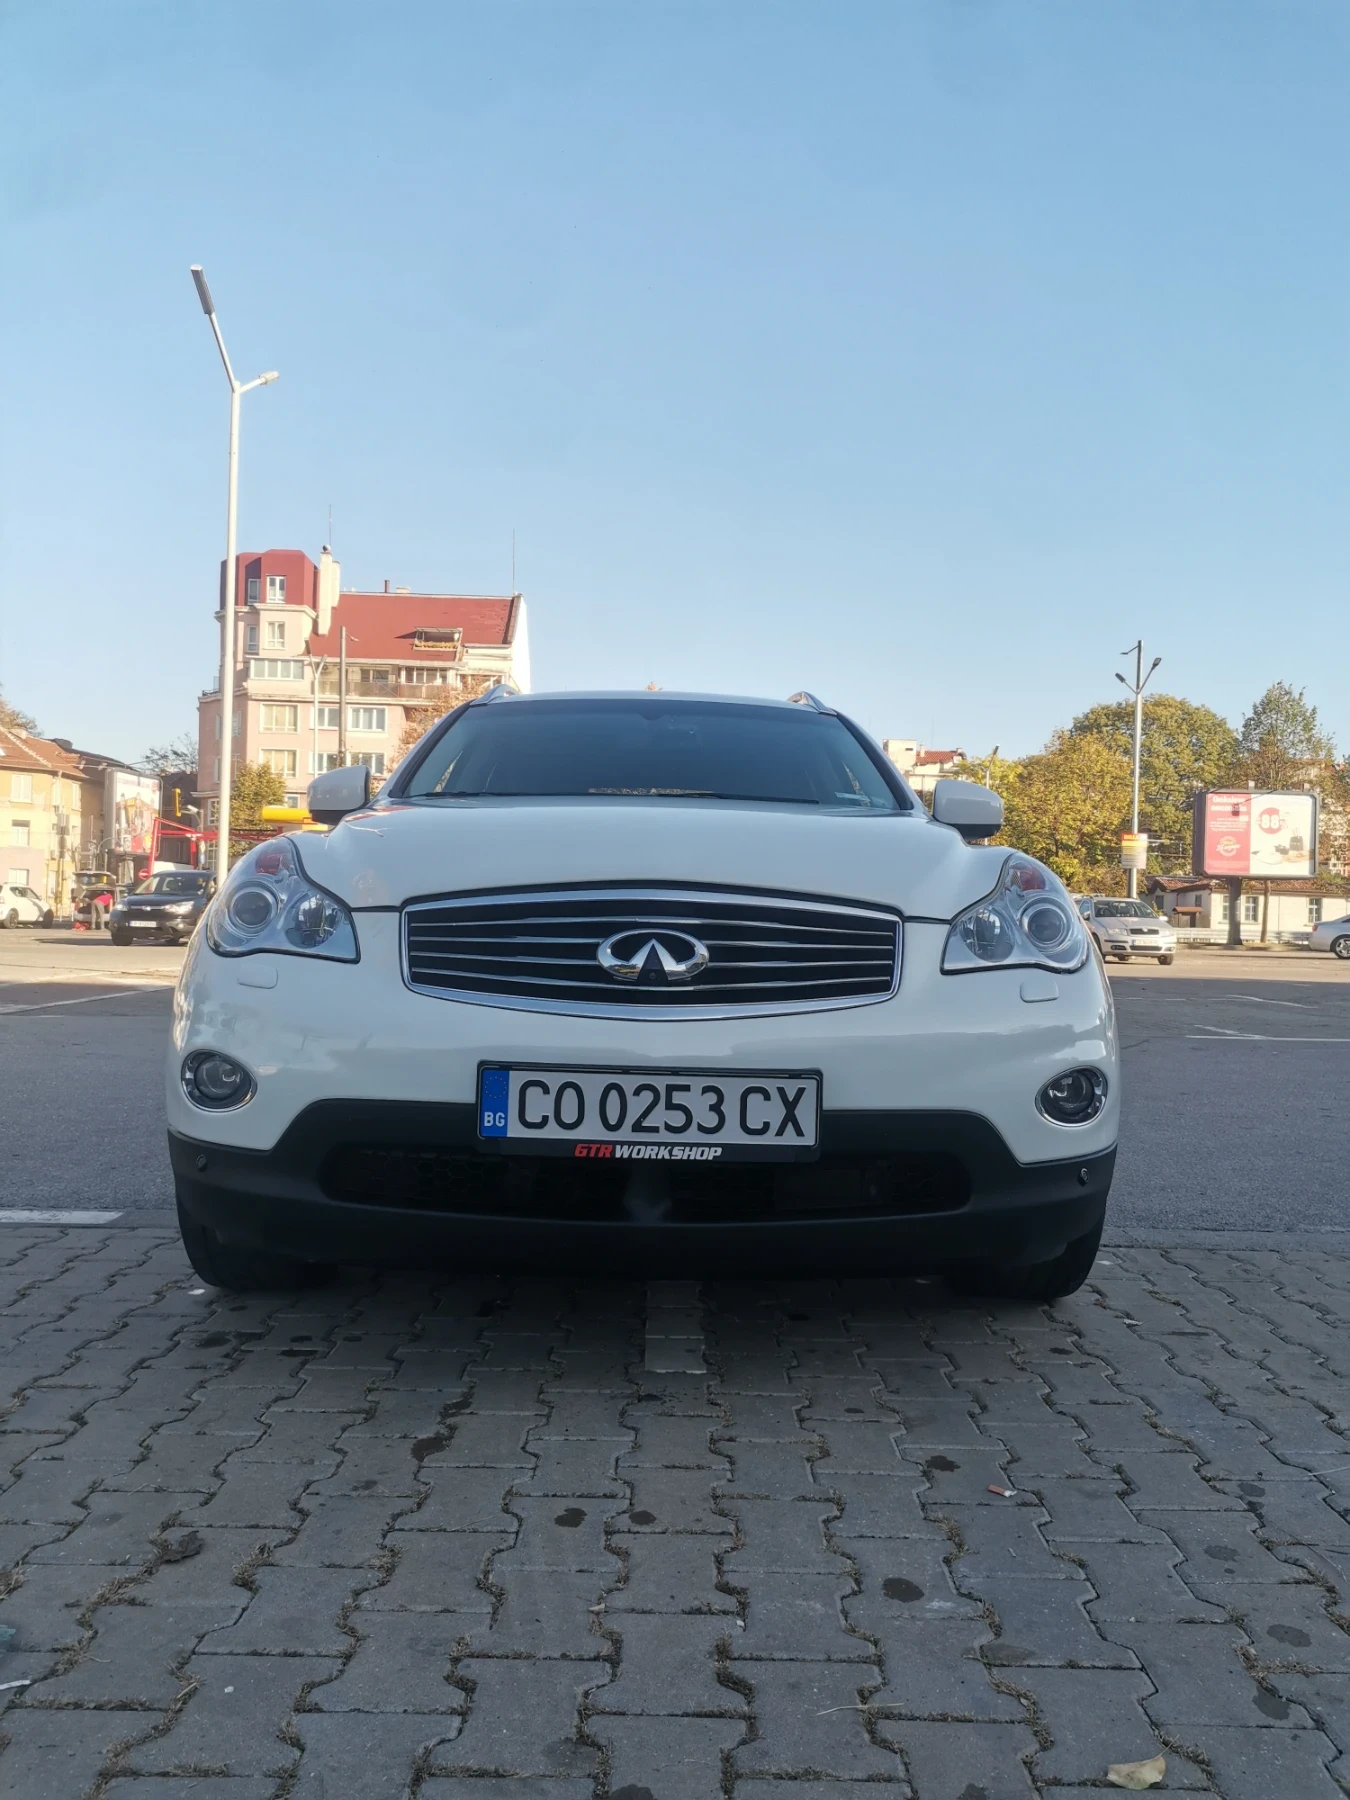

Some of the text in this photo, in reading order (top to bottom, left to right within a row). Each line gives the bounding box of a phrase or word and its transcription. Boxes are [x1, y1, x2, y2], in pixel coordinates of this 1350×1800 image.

[518, 1079, 807, 1137] CO 0253 CX
[483, 1111, 506, 1127] BG
[574, 1143, 723, 1160] GTR WORKSHOP
